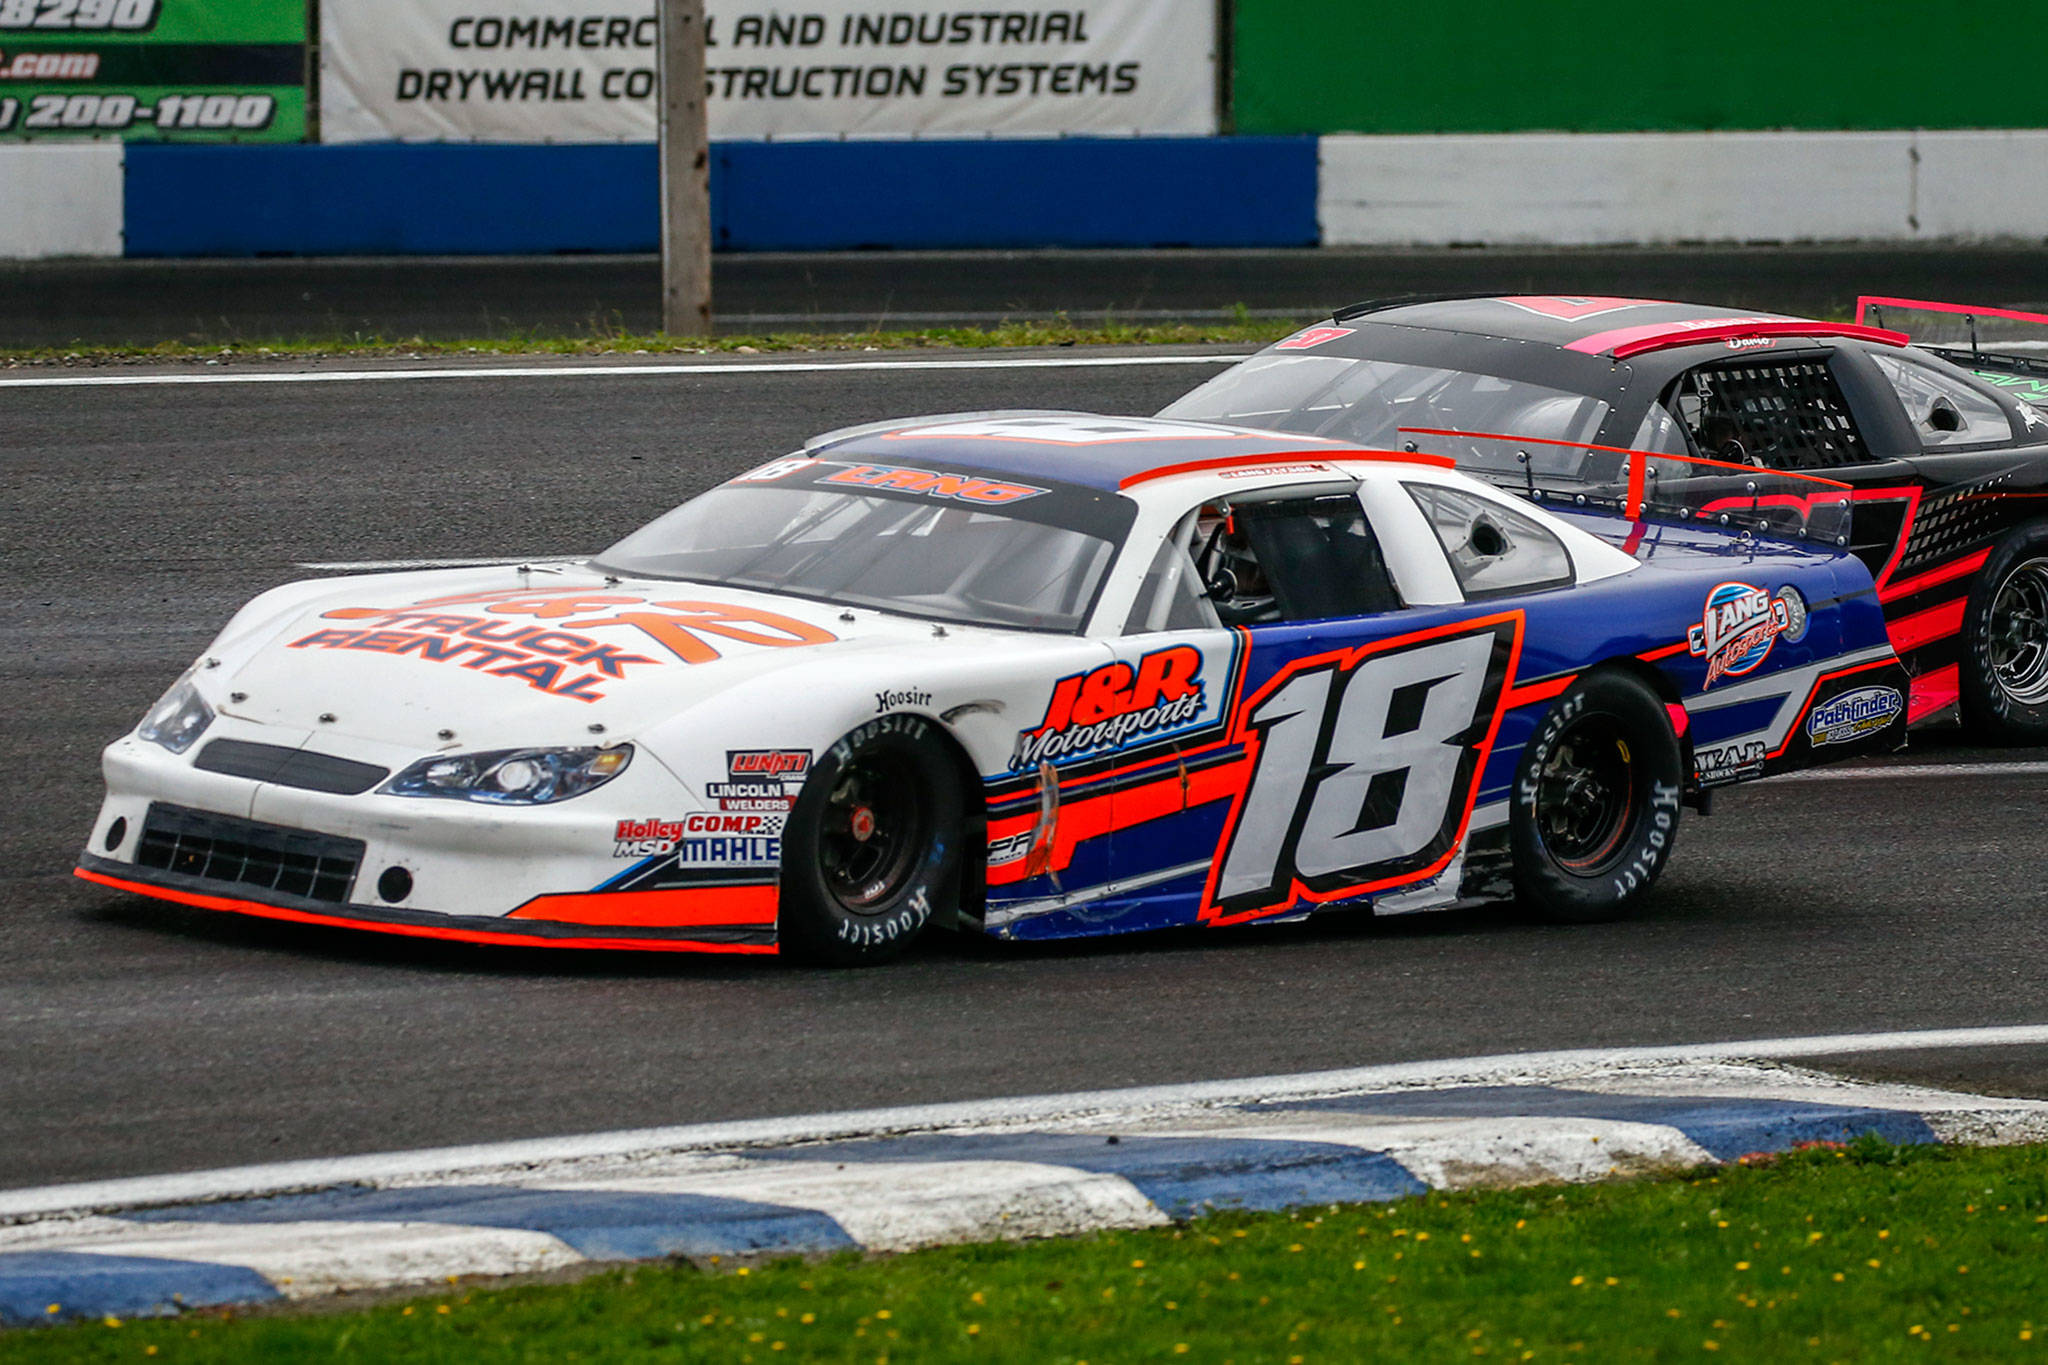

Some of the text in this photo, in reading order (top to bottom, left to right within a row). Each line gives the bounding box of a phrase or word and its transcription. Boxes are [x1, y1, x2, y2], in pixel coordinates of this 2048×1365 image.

[449, 11, 1089, 48] COMMERCL AND INDUSTRIAL
[396, 62, 1141, 101] DRYWALL COTRUCTION SYSTEMS
[25, 94, 274, 128] 200-1100
[822, 464, 1045, 502] LANG
[1705, 590, 1772, 661] LANG
[366, 611, 666, 680] TRUCK
[287, 628, 606, 704] RENTAL
[876, 686, 932, 713] Hoosier
[1022, 645, 1203, 740] J&R
[1813, 691, 1898, 729] Pathfinder
[1010, 692, 1202, 770] Motorsports
[734, 752, 806, 775] LUNATI
[1217, 631, 1496, 900] 18
[709, 783, 782, 798] LINCOLN
[726, 799, 789, 811] WELDERS
[615, 819, 684, 842] Holley
[688, 815, 762, 832] COMP
[1614, 779, 1680, 898] Hoosier
[613, 840, 676, 858] MSD
[682, 837, 780, 862] MAHLE
